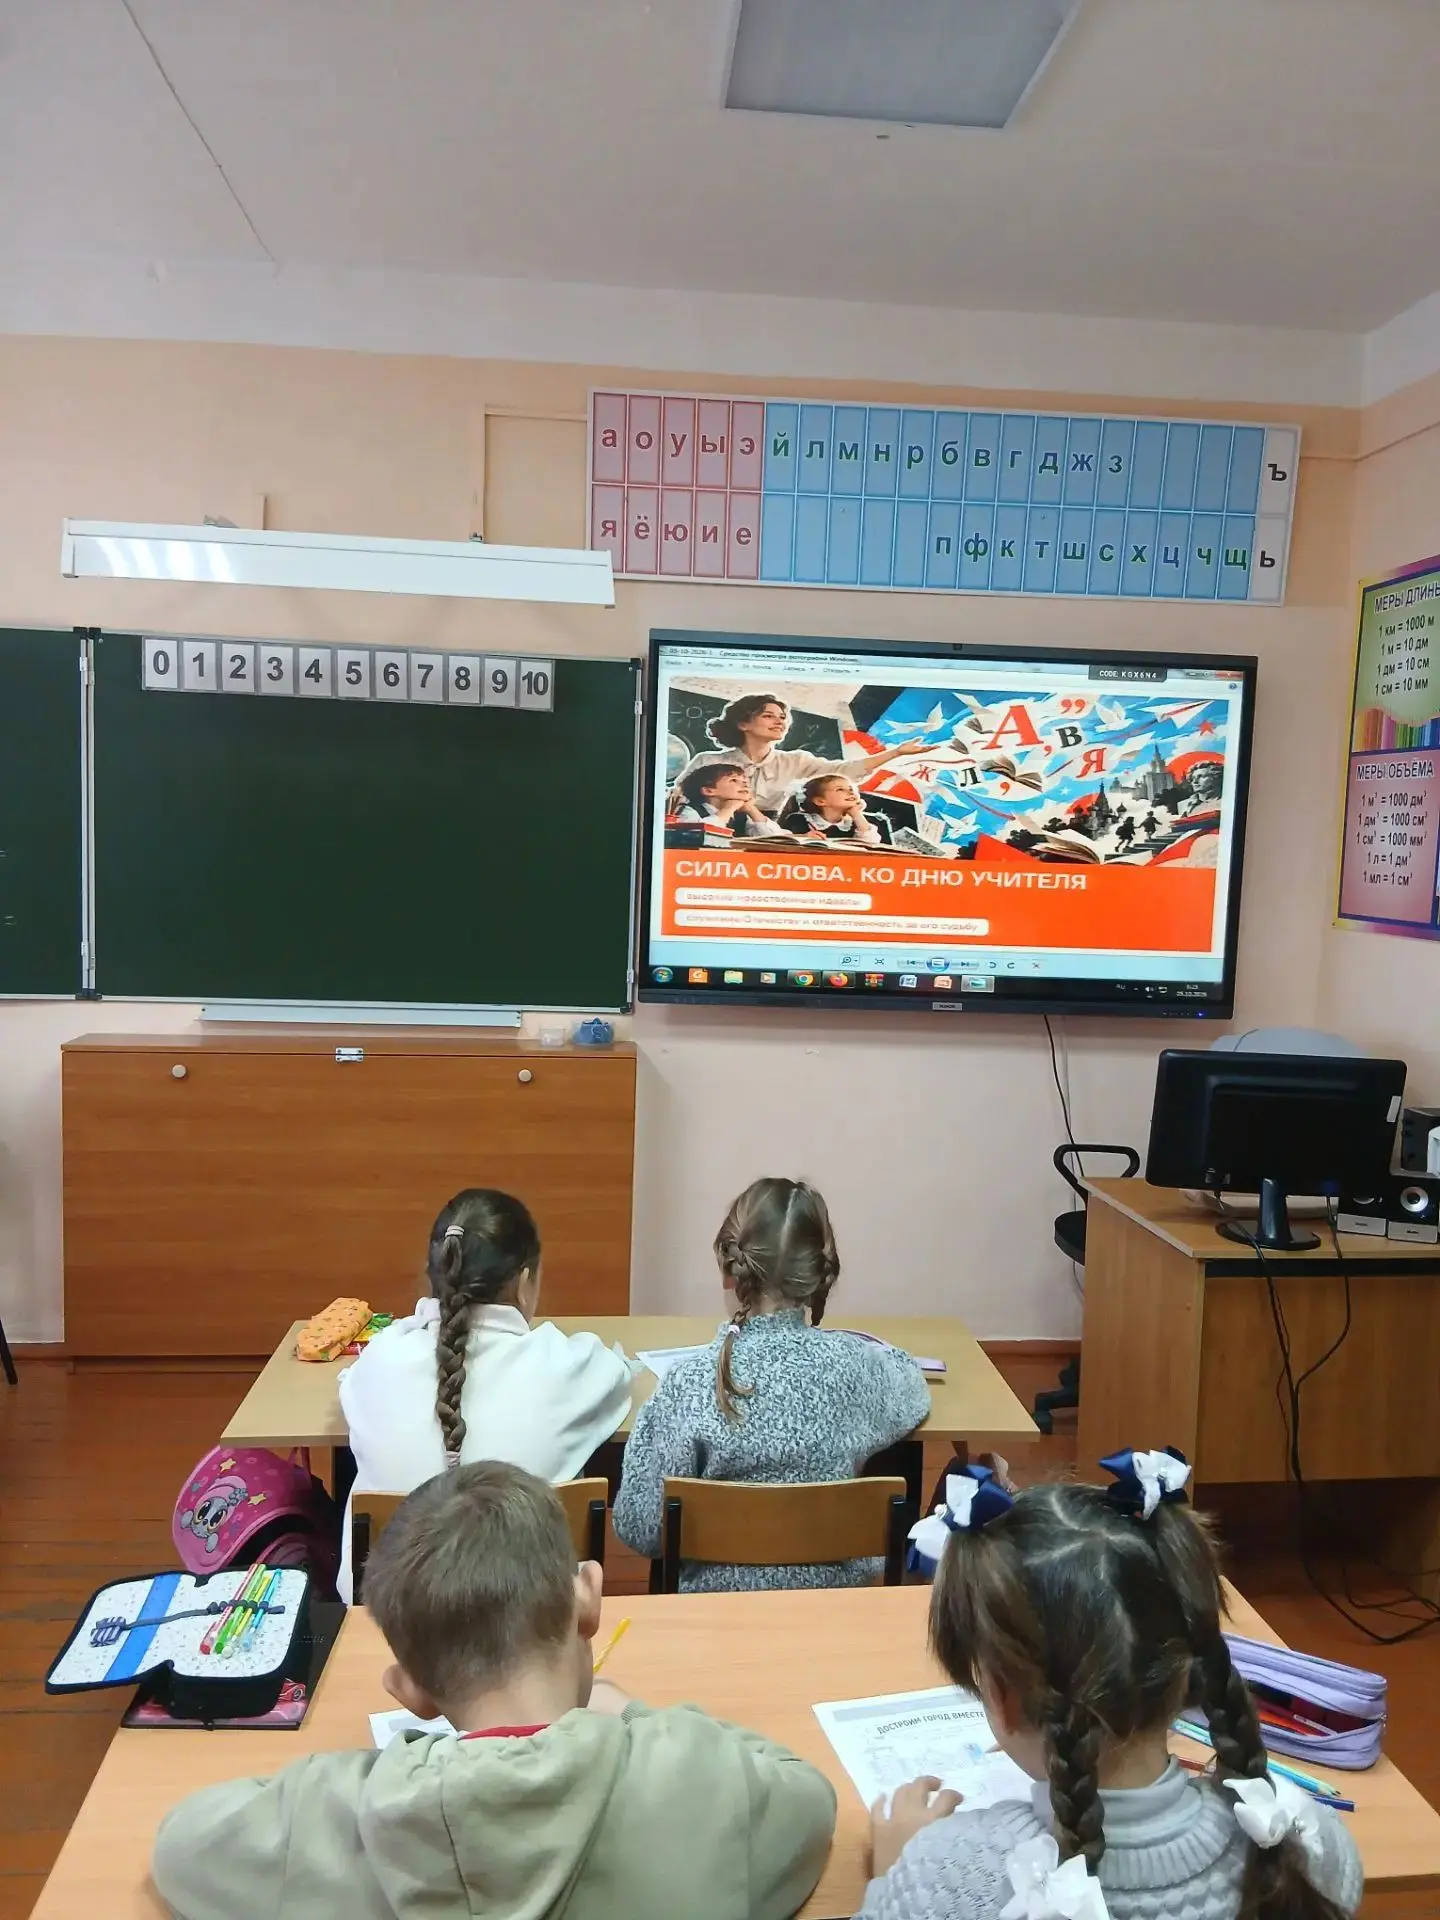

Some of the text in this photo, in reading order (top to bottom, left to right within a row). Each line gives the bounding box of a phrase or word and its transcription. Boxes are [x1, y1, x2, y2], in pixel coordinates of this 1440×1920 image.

[602, 429, 1287, 481] а о у ы э й л м н р б в г д ж з ъ
[601, 516, 1275, 570] я ё ю и е п ф к т ш с х ц ч щ ь
[1375, 592, 1403, 612] МЕРЫ
[153, 651, 548, 695] 0 1 2 3 4 5 6 7 8 9 10
[982, 705, 1045, 750] А
[1076, 748, 1107, 778] Я
[1357, 764, 1386, 779] МЕРЫ
[676, 861, 1087, 890] СИЛА СЛОВА. КО ДНЮ УЧИТЕЛЯ
[877, 1717, 922, 1734] ДОСТРОИМ
[923, 1713, 951, 1723] ГОРОД
